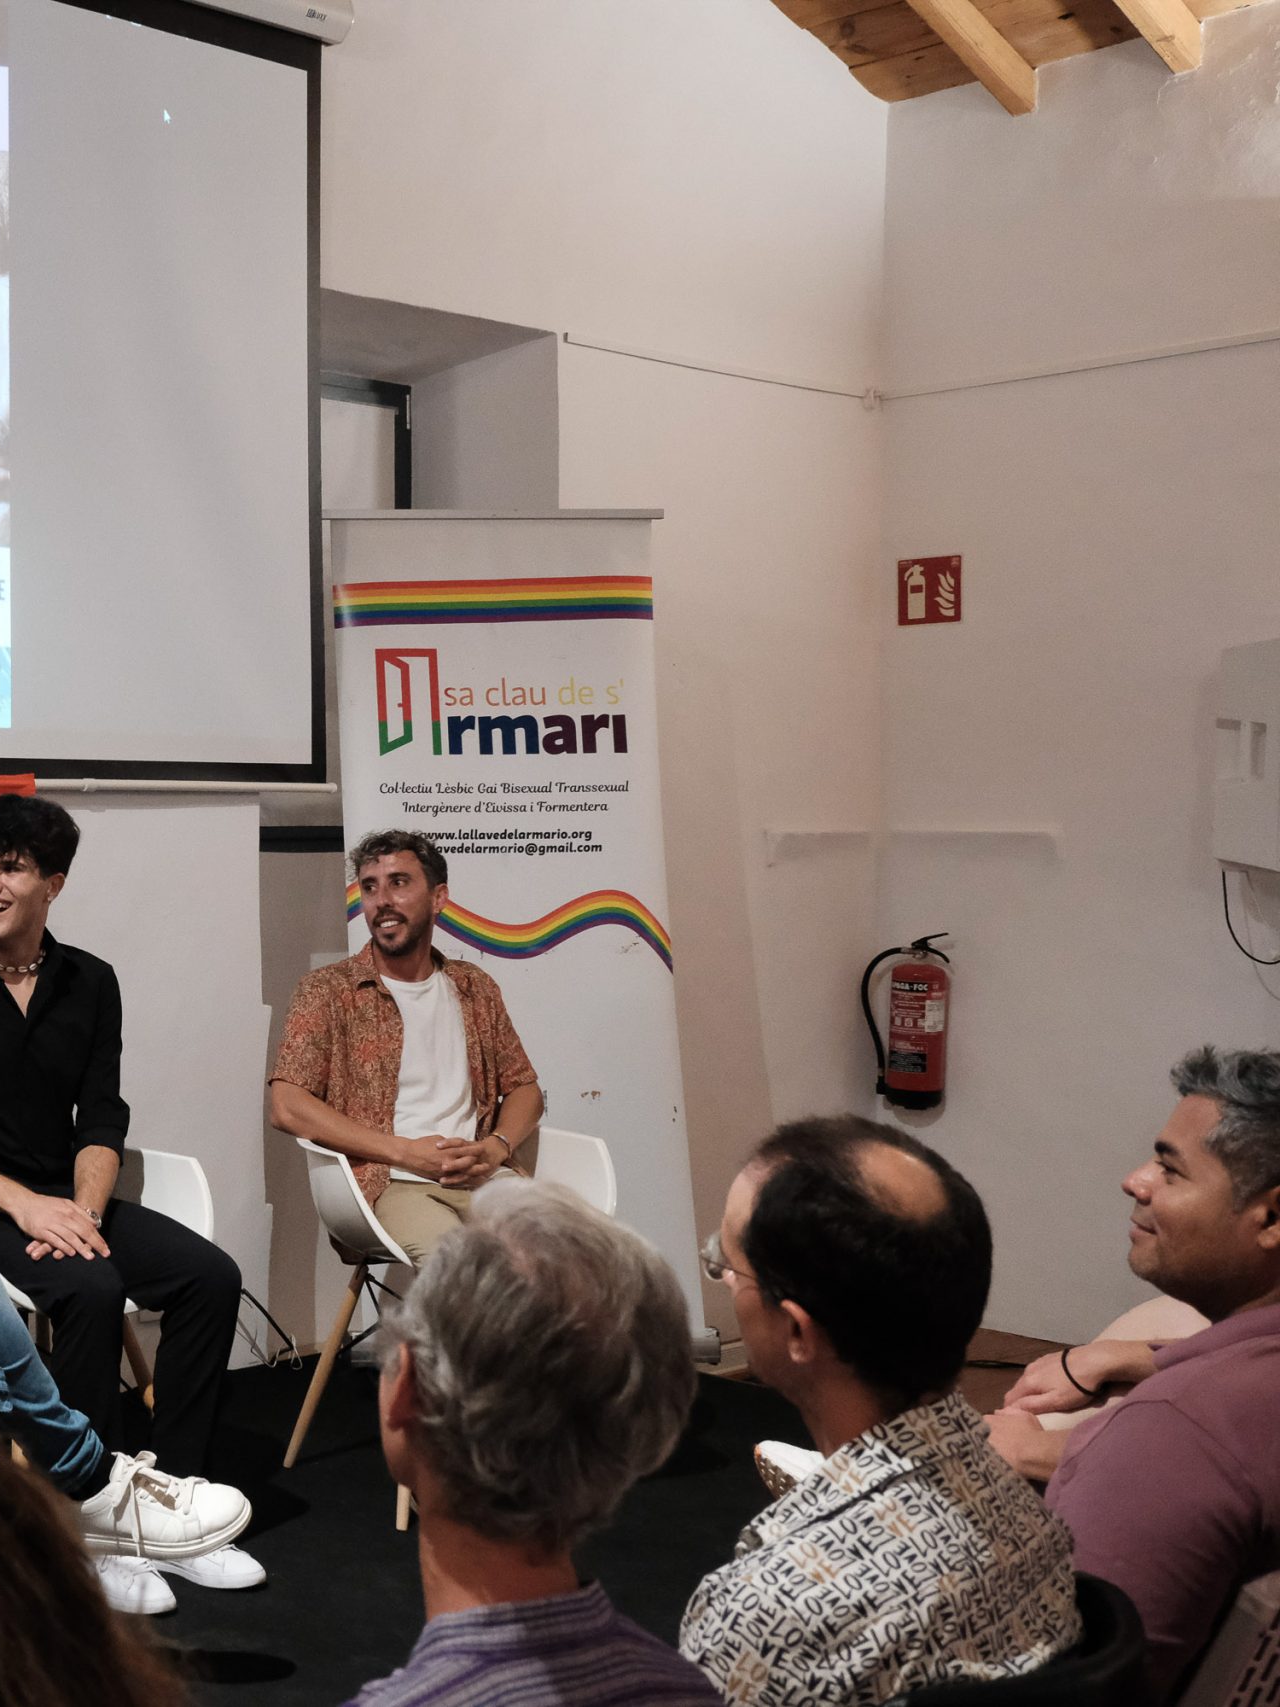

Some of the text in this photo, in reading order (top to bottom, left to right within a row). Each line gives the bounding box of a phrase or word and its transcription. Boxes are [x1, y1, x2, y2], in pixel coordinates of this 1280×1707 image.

[443, 686, 475, 707] sa
[484, 677, 547, 707] clau
[557, 675, 595, 706] de
[435, 781, 475, 795] Lèsbic
[476, 782, 498, 795] Gai
[499, 780, 553, 795] Bisexual
[555, 780, 630, 794] Transsexual
[401, 800, 472, 818] Intergènere
[473, 800, 528, 814] d'Eivissa
[535, 800, 609, 814] Formentera
